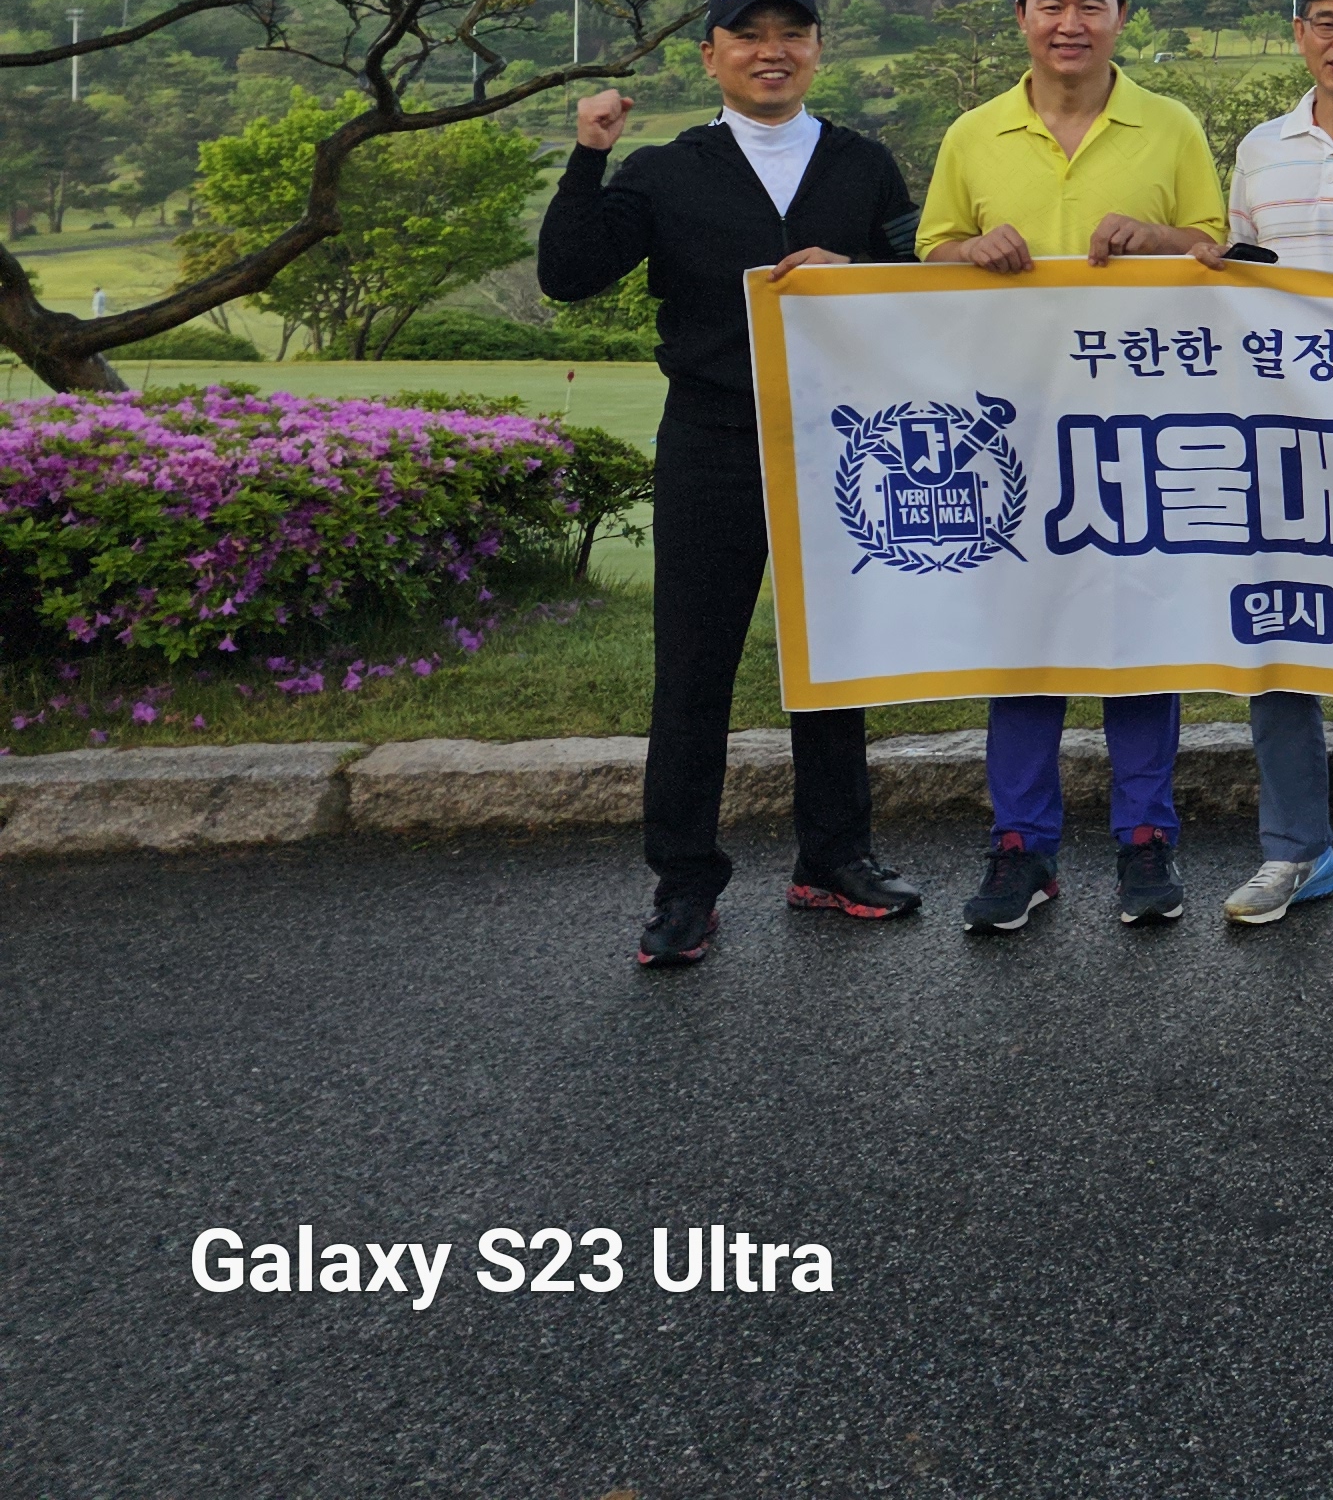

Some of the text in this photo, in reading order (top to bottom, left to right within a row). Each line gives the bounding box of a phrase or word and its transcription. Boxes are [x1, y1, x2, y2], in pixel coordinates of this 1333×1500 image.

[1070, 326, 1223, 379] 무한한
[895, 488, 971, 506] VERI LUX
[899, 506, 975, 524] TAS MEA
[1245, 590, 1324, 635] 일시
